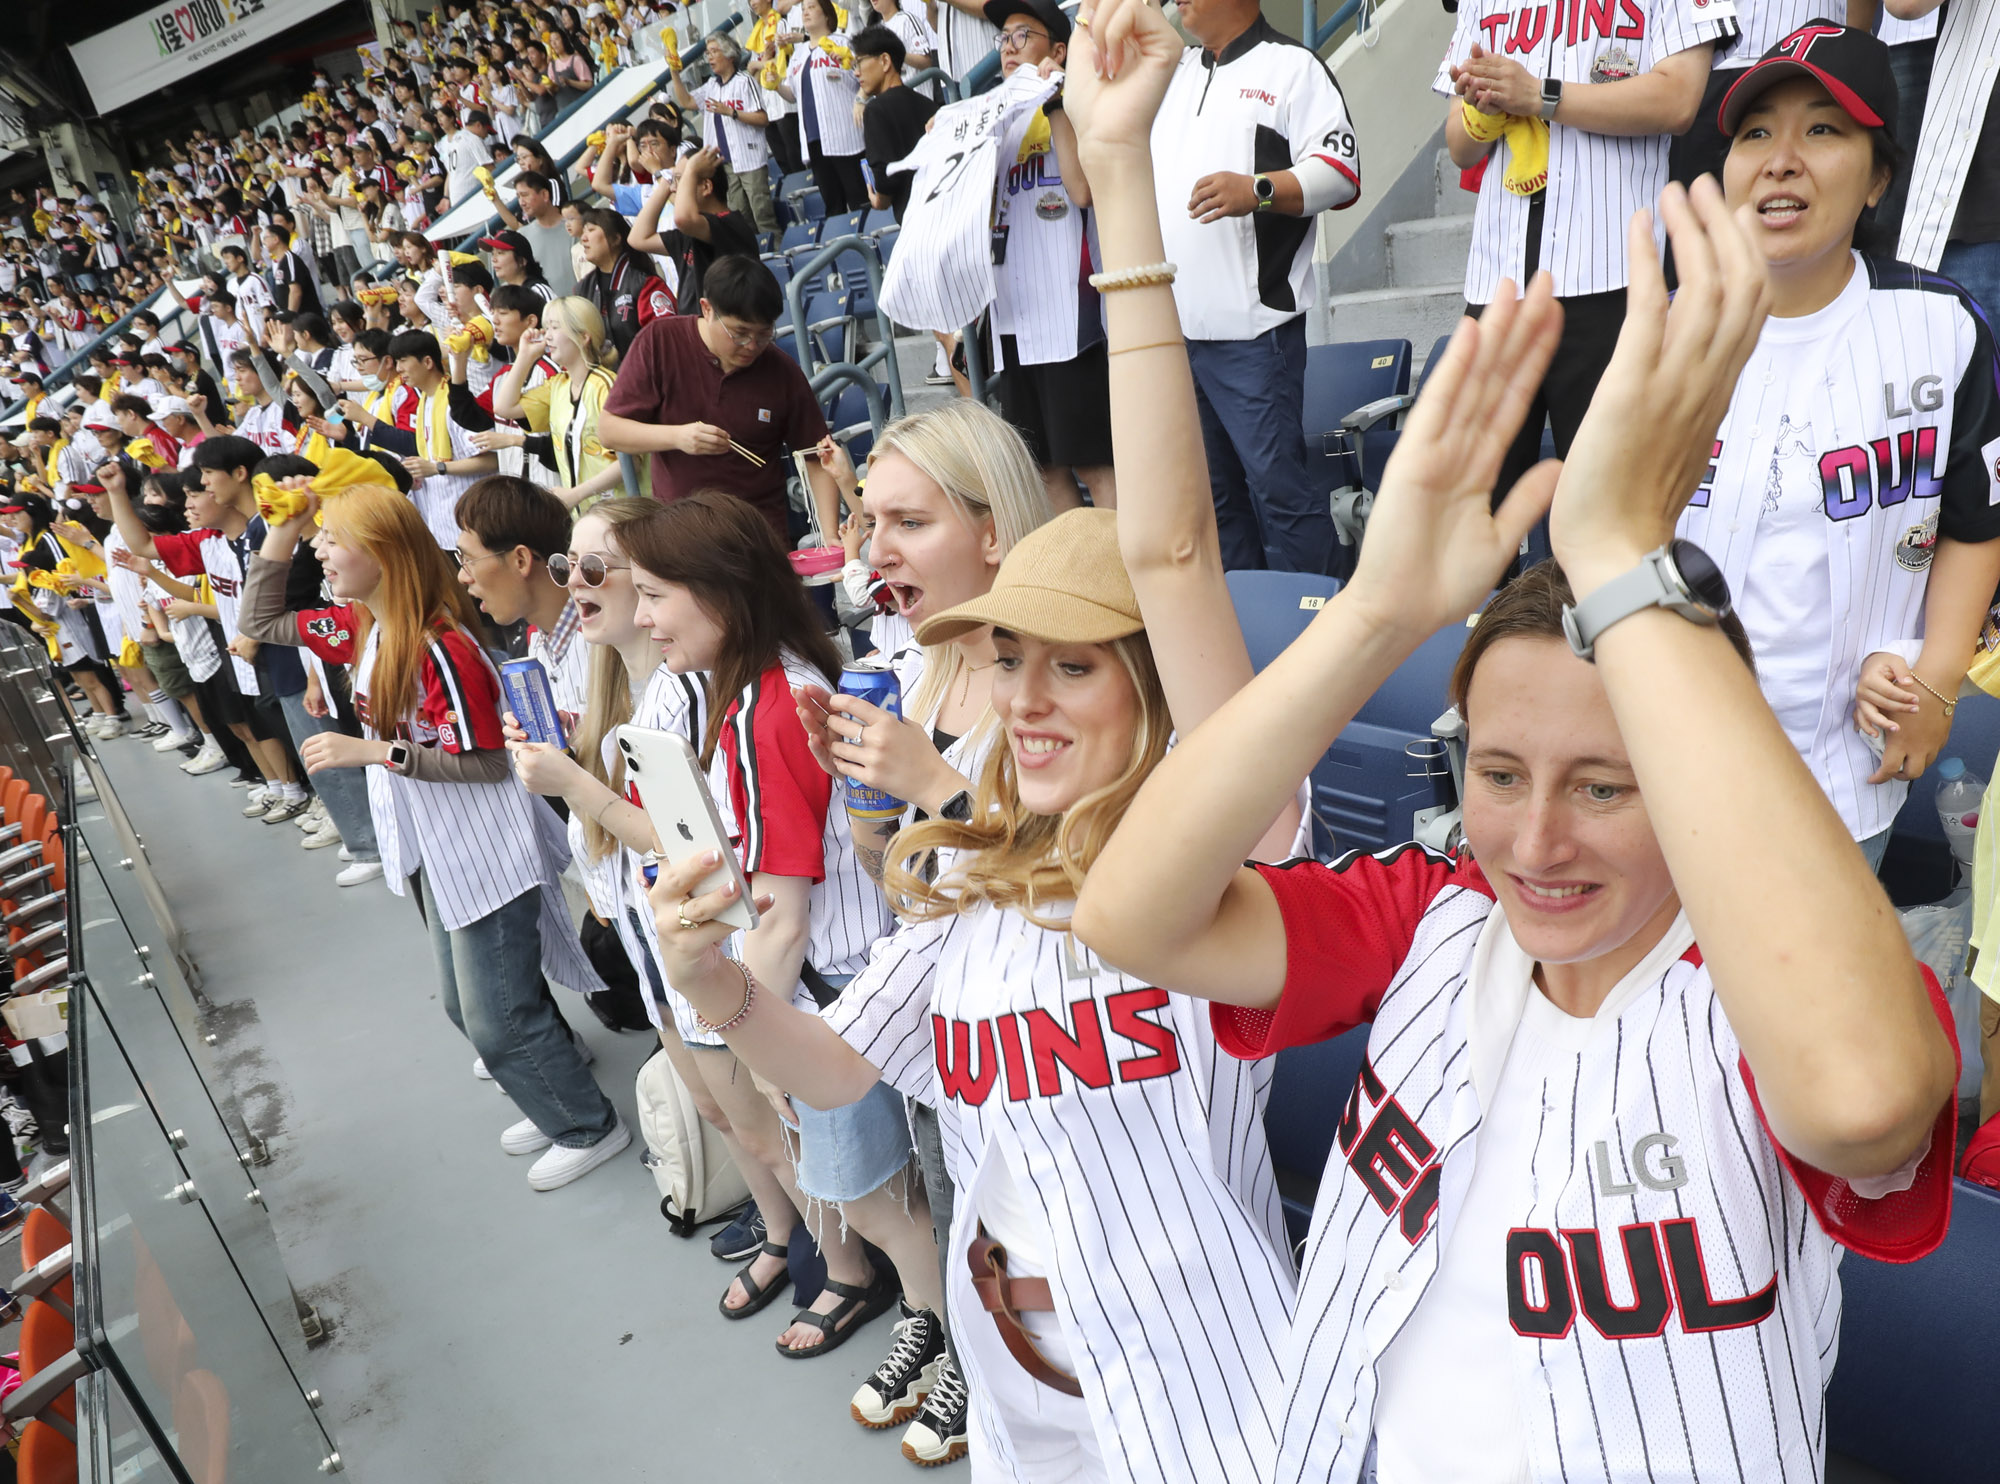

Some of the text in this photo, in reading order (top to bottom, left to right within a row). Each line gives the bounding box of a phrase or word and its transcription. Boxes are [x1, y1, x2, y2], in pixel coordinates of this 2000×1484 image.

[1480, 0, 1645, 54] TWINS
[1239, 88, 1277, 106] TWINS
[1322, 130, 1356, 158] 69
[924, 139, 989, 205] 27
[1377, 358, 1388, 366] 40
[1884, 374, 1944, 420] LG
[1817, 426, 1944, 522] OUL
[1308, 599, 1318, 607] 18
[850, 787, 887, 800] BREWED
[932, 986, 1181, 1107] WINS
[1594, 1131, 1690, 1198] LG
[1506, 1216, 1779, 1340] OUL
